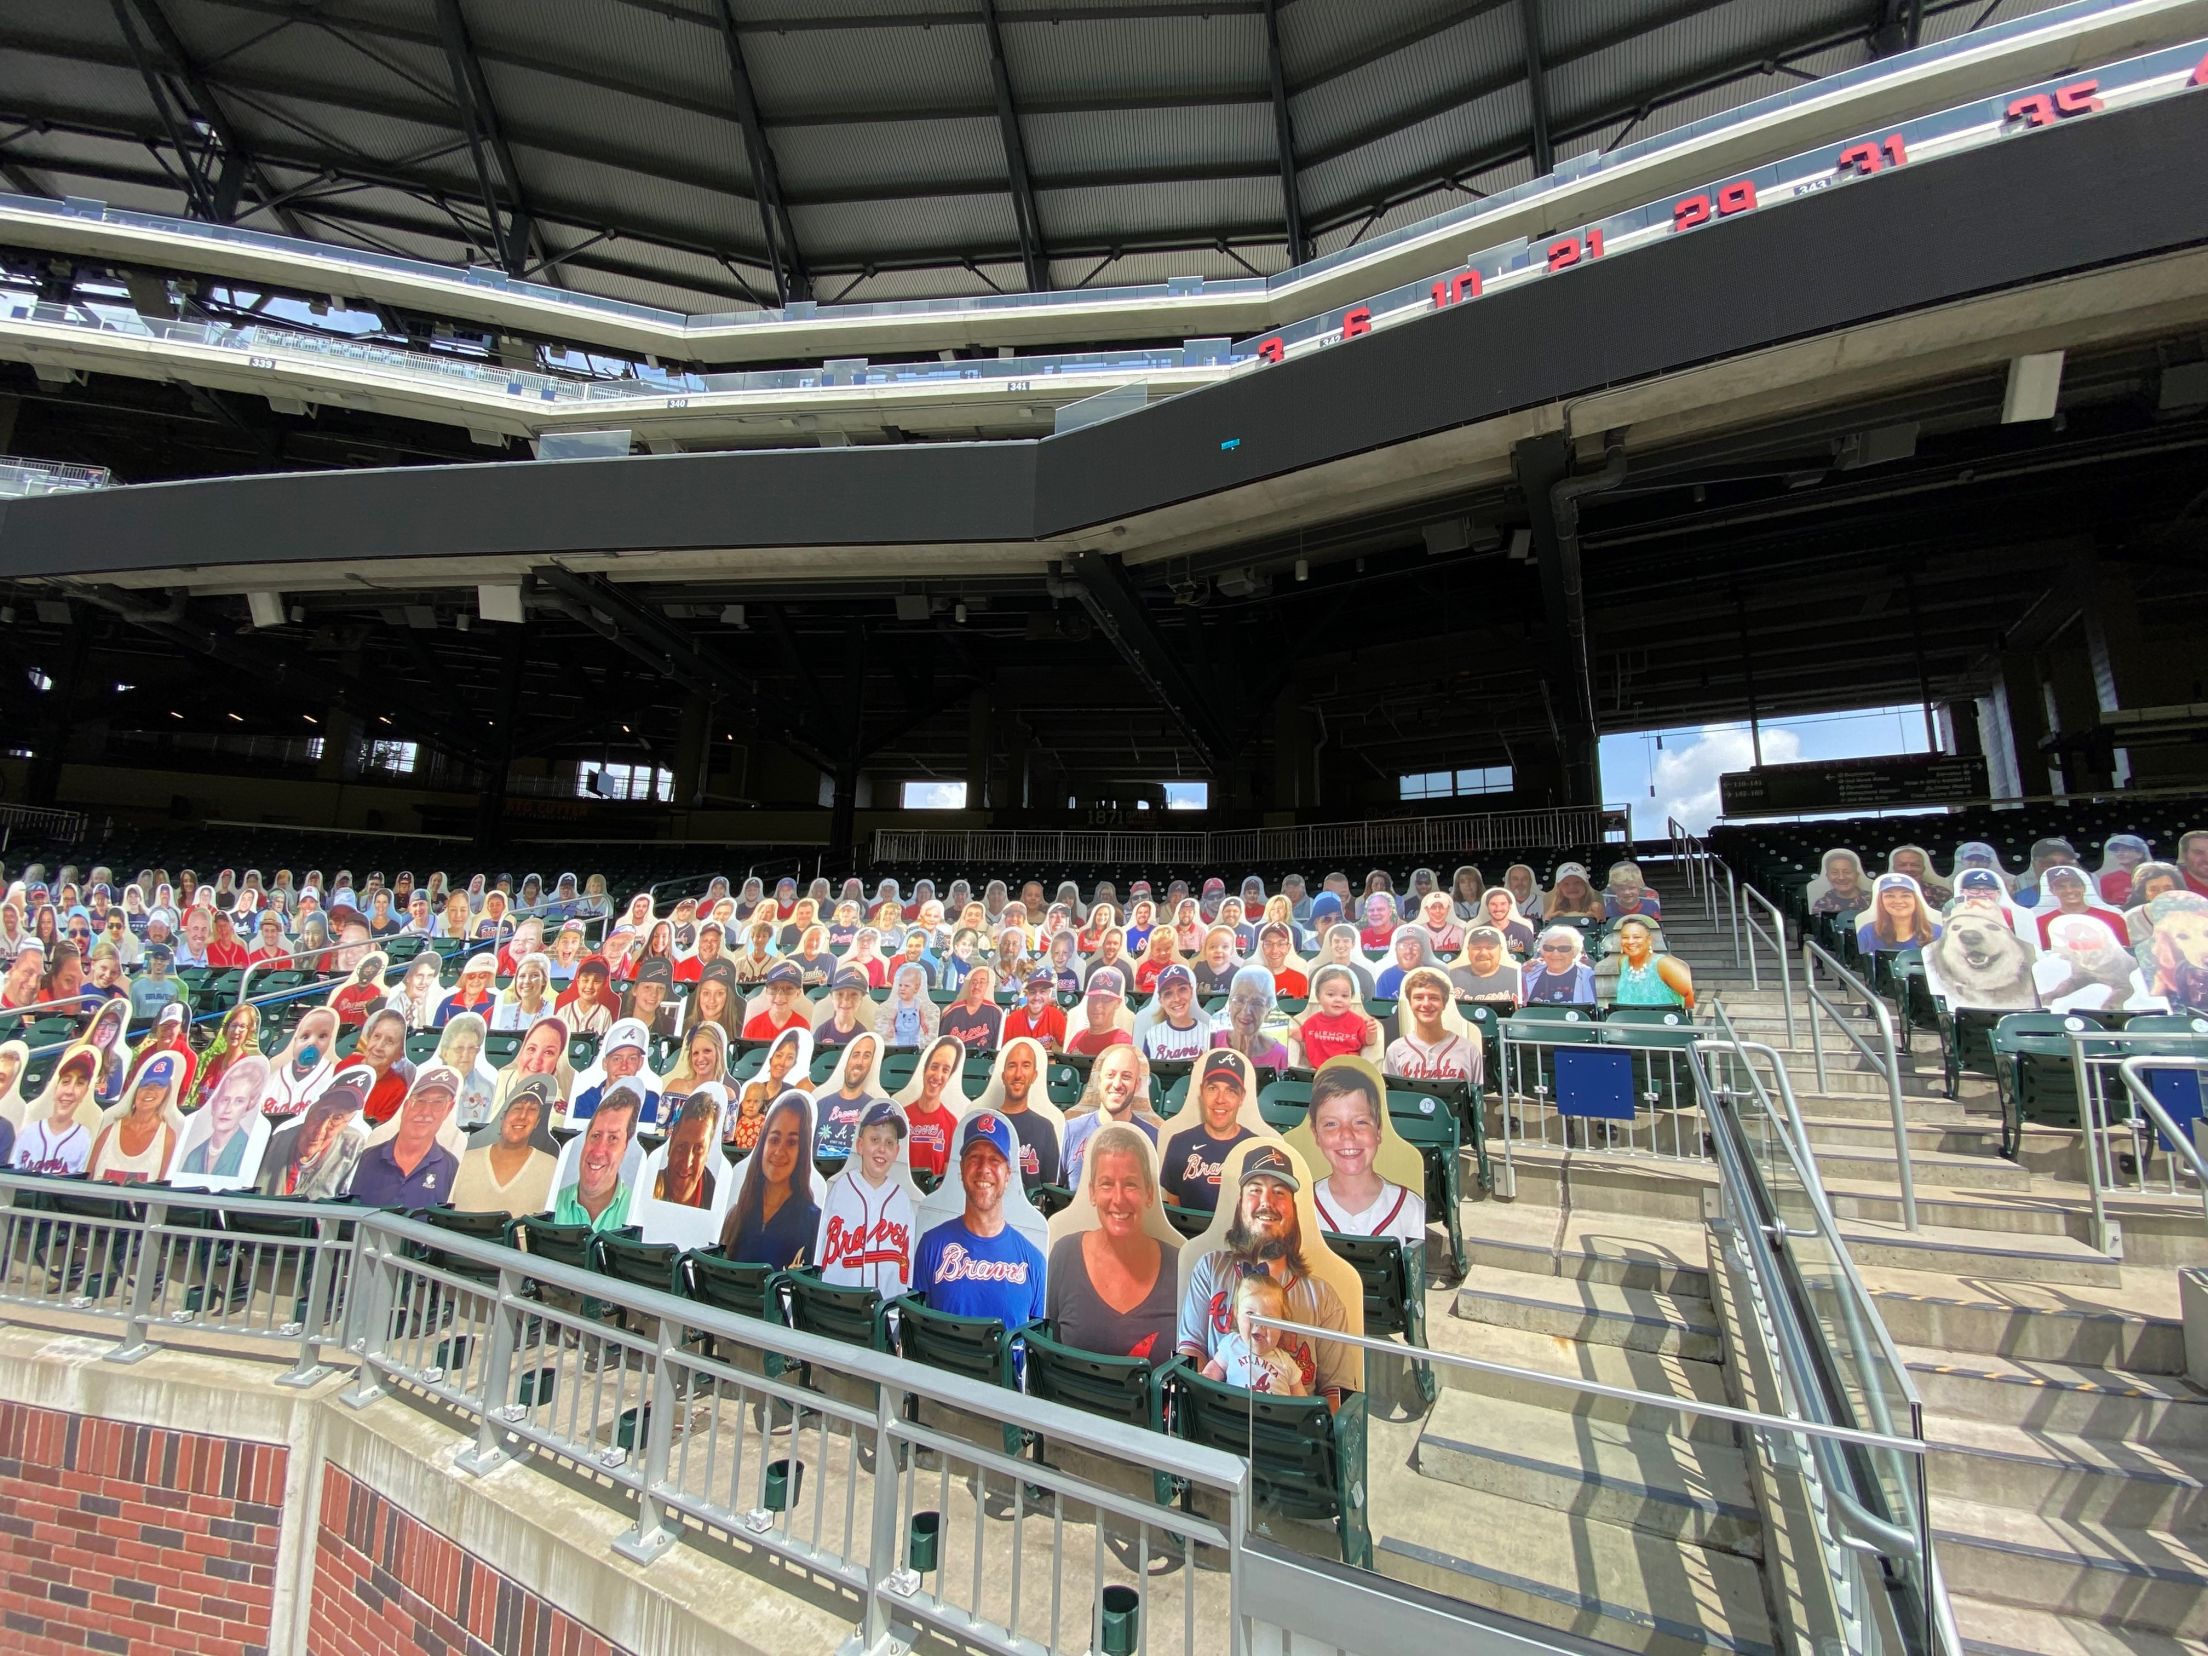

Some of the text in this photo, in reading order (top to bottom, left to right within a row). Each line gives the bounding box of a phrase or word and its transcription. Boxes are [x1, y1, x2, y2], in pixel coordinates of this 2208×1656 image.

[2005, 79, 2104, 127] 35
[1839, 133, 1908, 173] 31
[1674, 179, 1757, 232] 29
[1547, 228, 1604, 273] 21
[1432, 269, 1483, 309] 10
[1343, 305, 1371, 339] 6
[1258, 337, 1285, 363] 3
[252, 359, 273, 369] 339
[1011, 382, 1026, 391] 341
[669, 400, 686, 409] 340
[1155, 1044, 1199, 1060] Braves
[1219, 1053, 1236, 1067] A
[346, 1070, 368, 1088] A
[909, 1123, 940, 1136] raves
[1182, 1153, 1223, 1181] Bra
[821, 1215, 909, 1274] Braves
[934, 1242, 1030, 1285] Braves
[1237, 1354, 1281, 1380] ATLANTA
